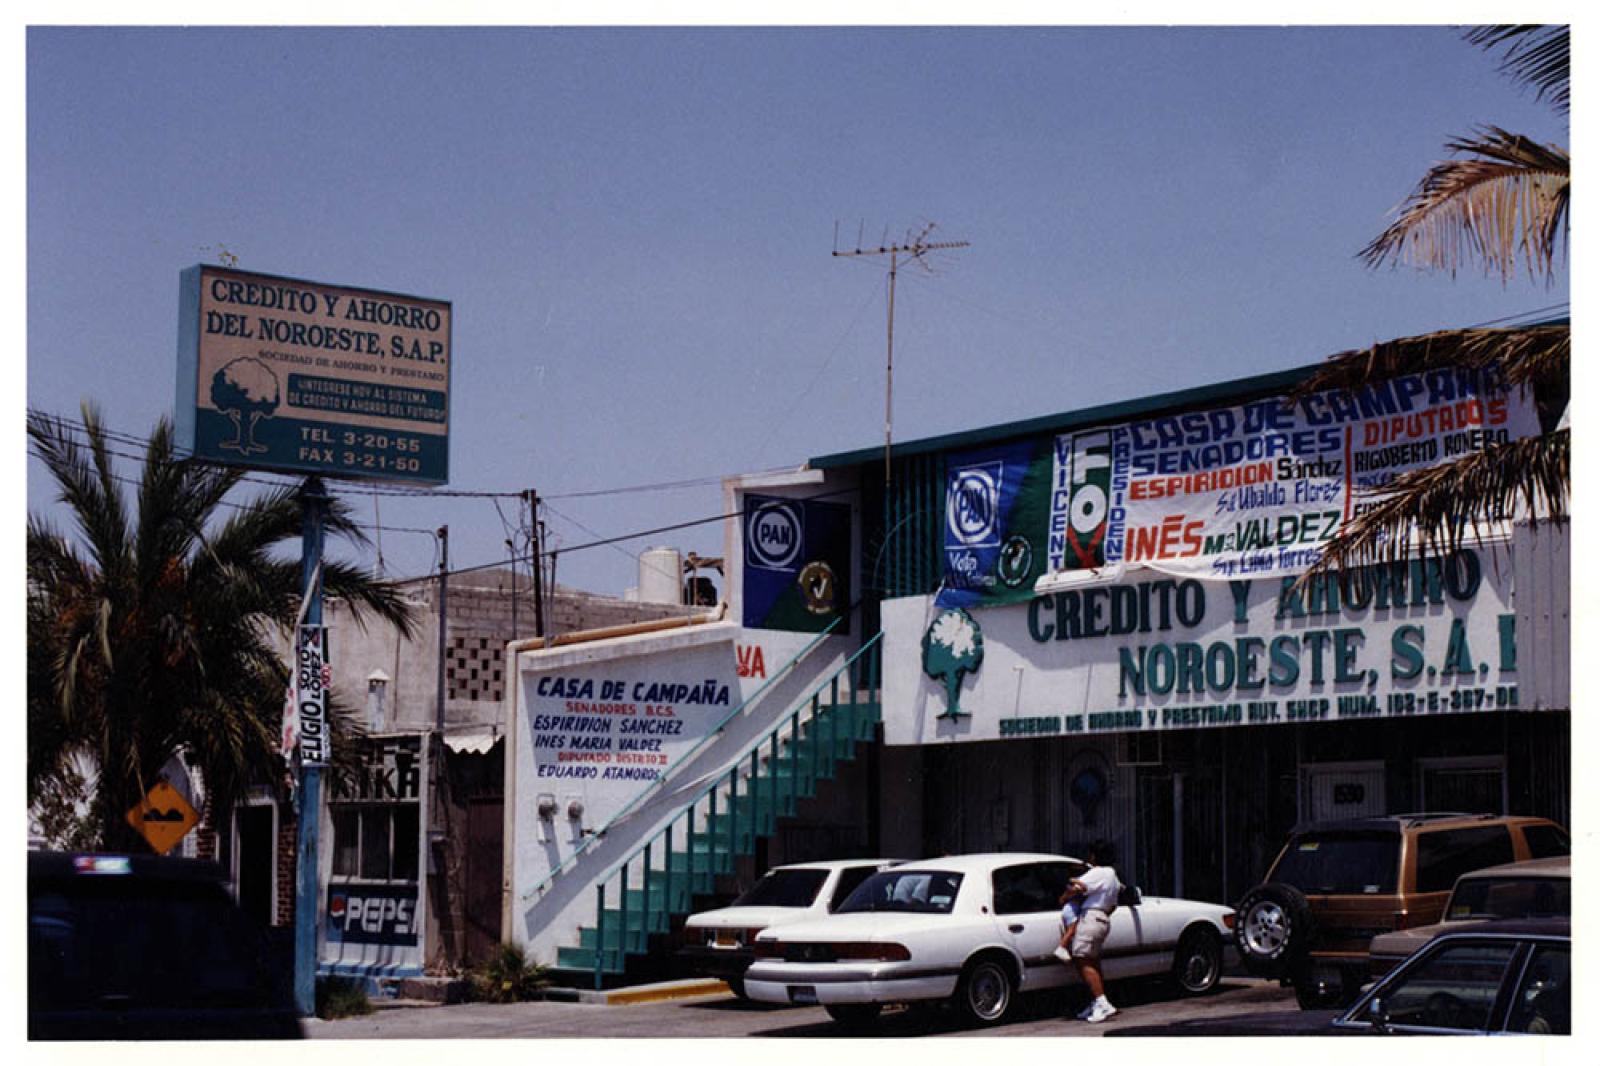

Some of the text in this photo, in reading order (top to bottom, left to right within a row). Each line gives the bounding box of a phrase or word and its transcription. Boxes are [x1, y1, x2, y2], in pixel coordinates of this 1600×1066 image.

[211, 279, 441, 332] CREDITO Y AHORRO
[206, 309, 446, 364] DEL NOROESTE, S.A.P.
[258, 351, 445, 382] SOCIEDAD DE AHORRO Y PRESTAMO
[301, 427, 335, 443] TEL
[1130, 408, 1235, 450] CASA
[1243, 397, 1295, 434] DE
[1364, 398, 1508, 447] DIPUTADOS
[299, 447, 334, 463] FAX
[1132, 428, 1342, 477] SENADORES
[1354, 438, 1438, 473] RIGOBERTO
[1130, 462, 1273, 500] ESPIRIDION
[761, 523, 790, 545] PAN
[1236, 510, 1341, 551] VALDEZ
[1027, 579, 1206, 643] CREDITO
[1229, 579, 1252, 623] Y
[300, 649, 310, 691] SOTO
[311, 650, 321, 699] LOPEZ
[1118, 627, 1379, 698] NOROESTE,
[537, 676, 729, 706] CASA DE CAMPAÑA
[565, 700, 637, 716] SENADORES
[301, 701, 322, 764] ELIGIO
[533, 714, 683, 735] ESPIRIDION SANCHEZ
[1066, 715, 1083, 732] DE
[1147, 709, 1157, 727] Y
[1163, 703, 1242, 726] PRESTAMO
[535, 734, 662, 752] INES MARIA VALDEZ
[558, 752, 610, 764] DIPUTADO
[616, 753, 658, 765] DISTRITO
[538, 764, 597, 779] EDUARDO
[344, 897, 417, 934] PEPSI
